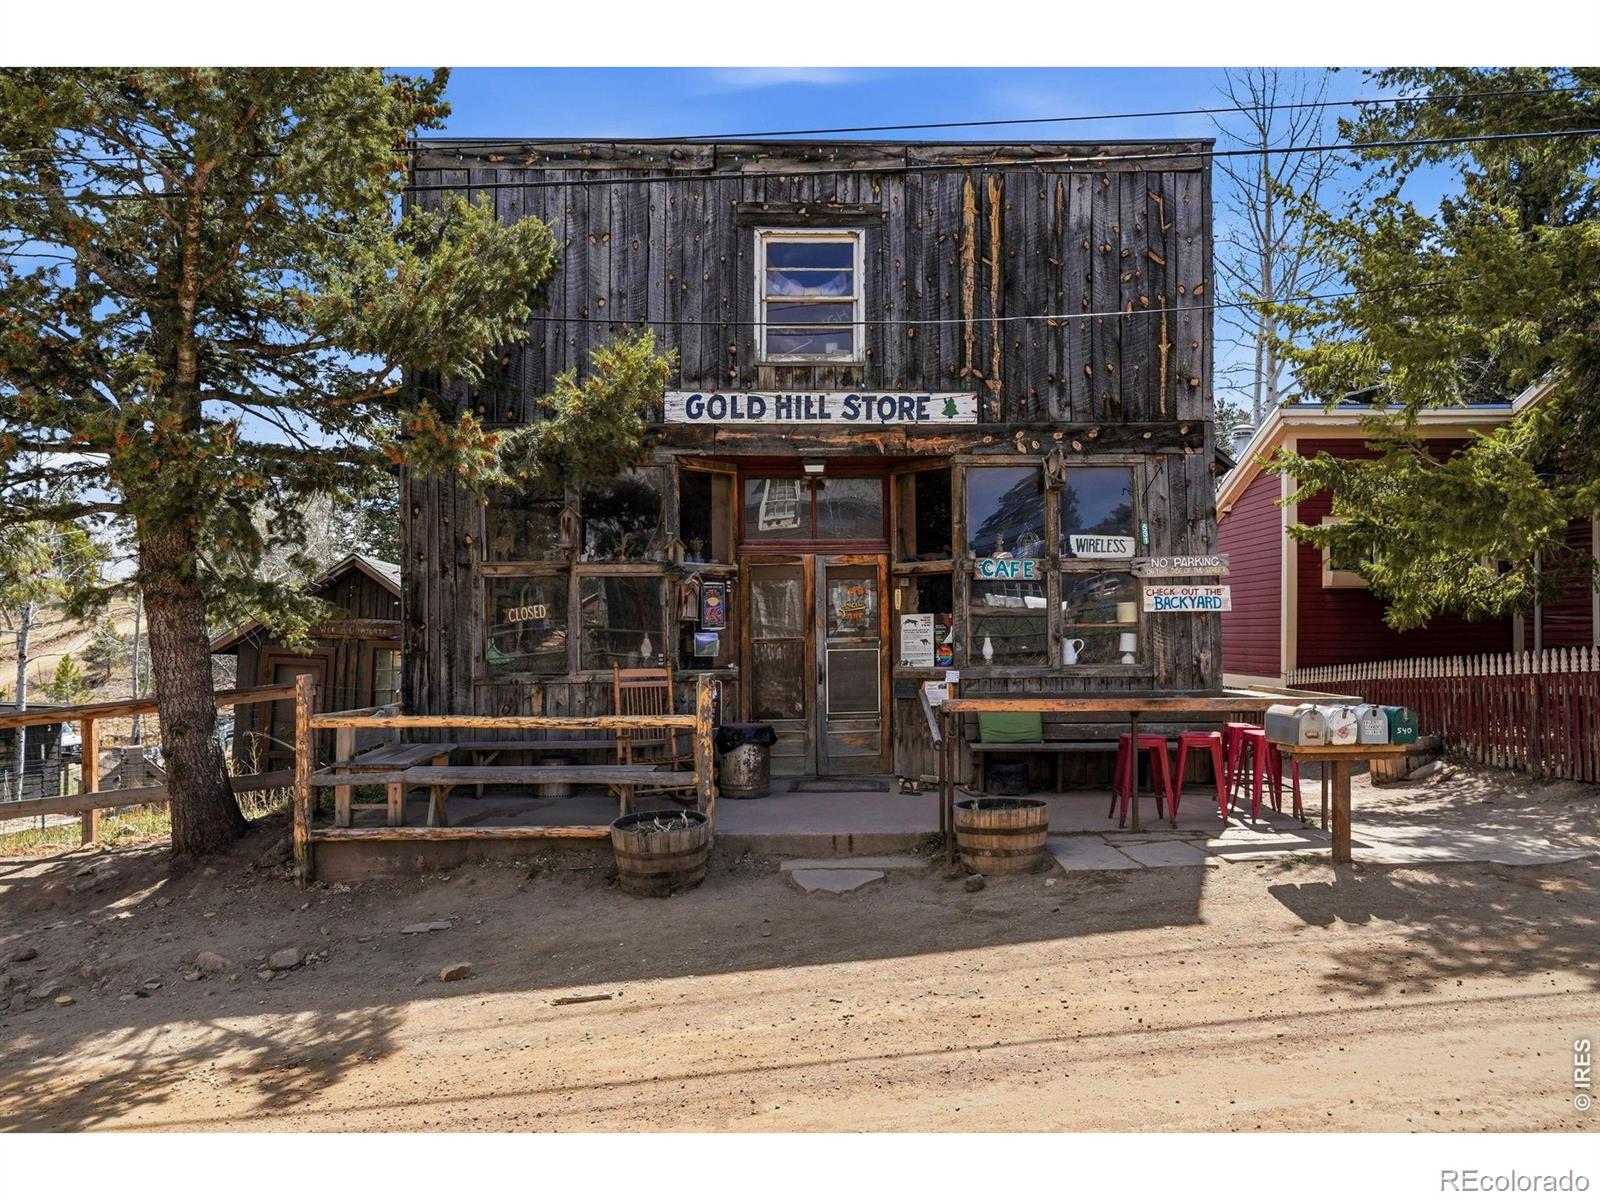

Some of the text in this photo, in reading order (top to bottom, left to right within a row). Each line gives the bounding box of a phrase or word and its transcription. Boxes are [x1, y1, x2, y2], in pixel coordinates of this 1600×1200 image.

[685, 394, 930, 421] GOLD HILL STORE
[1076, 538, 1127, 554] WIRELESS
[980, 559, 1035, 579] CAFE
[1151, 556, 1220, 568] NO PARKING
[1146, 588, 1223, 596] CHECK OUT THE
[1153, 596, 1222, 611] BACKYARD
[508, 604, 546, 623] CLOSED
[1397, 727, 1412, 735] 540
